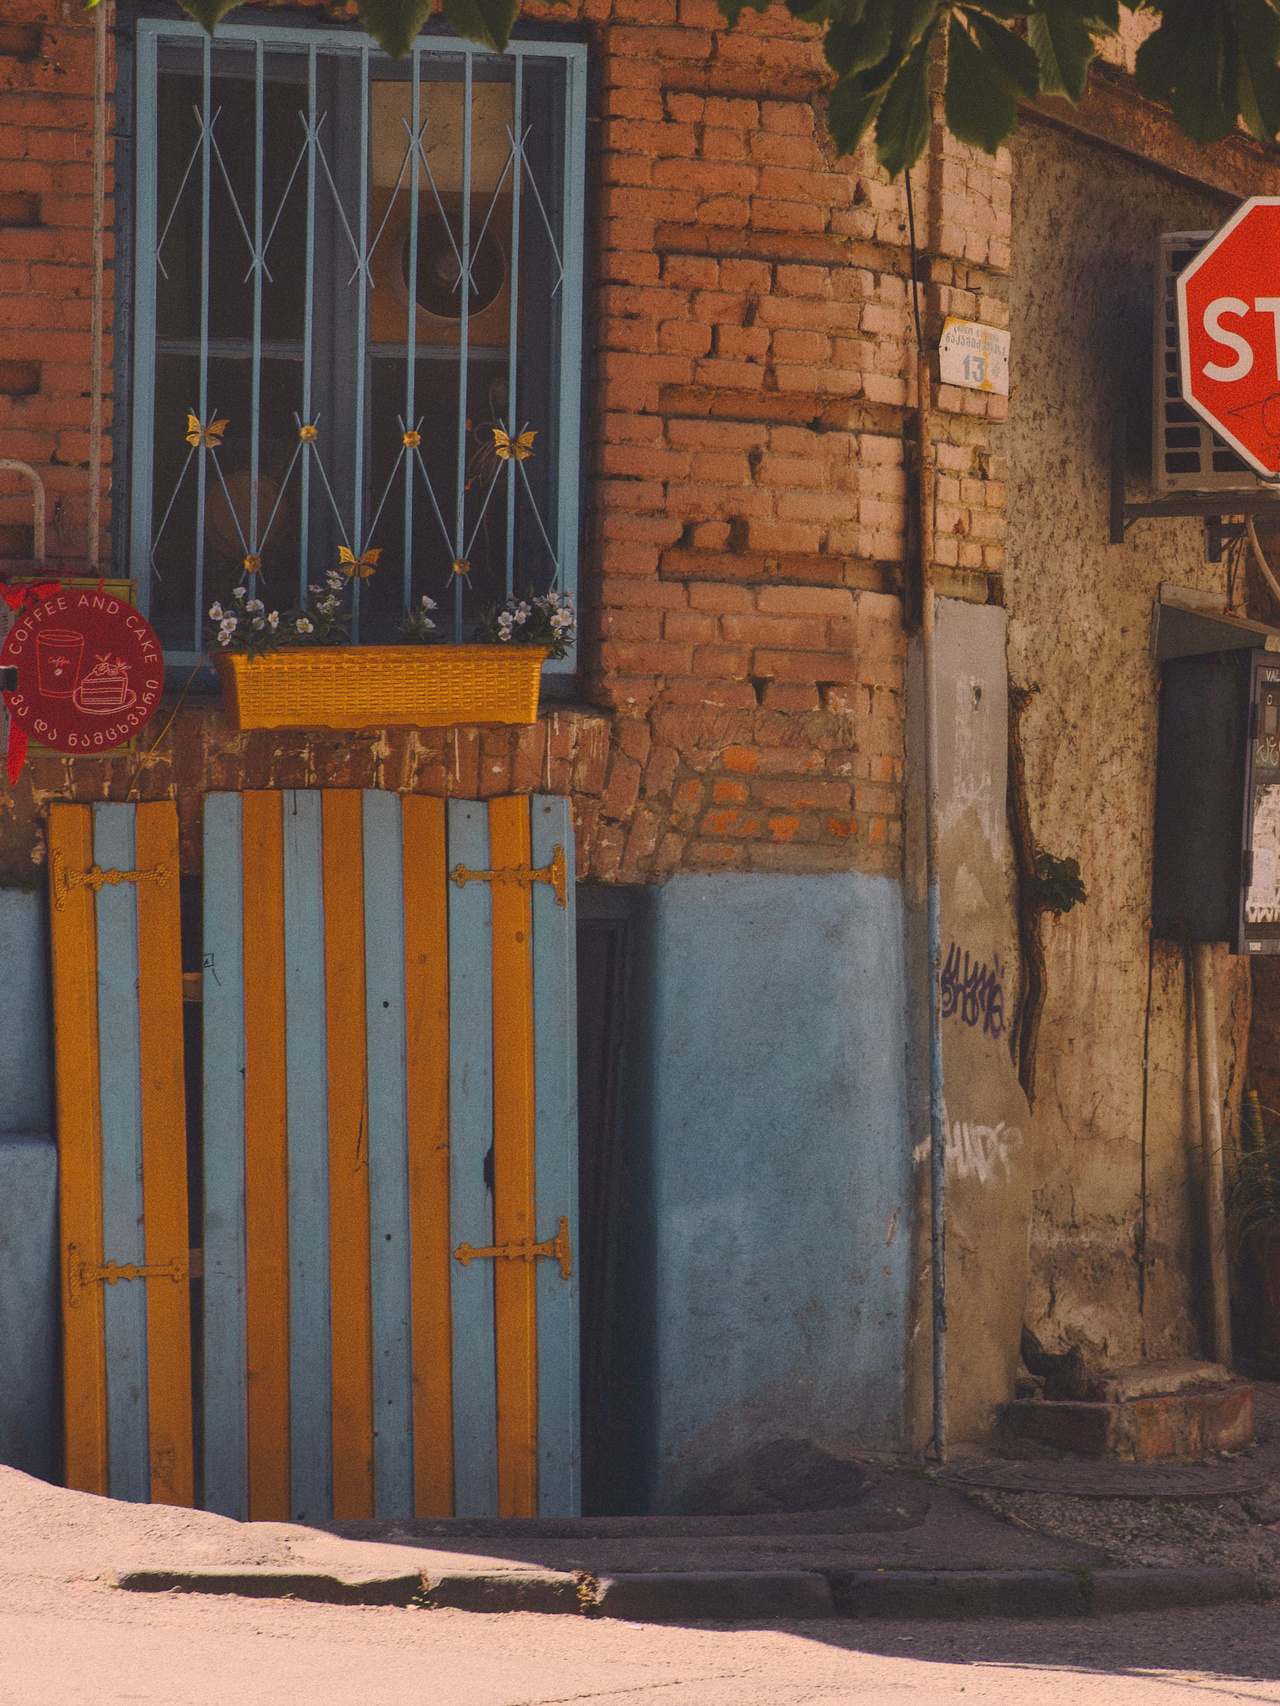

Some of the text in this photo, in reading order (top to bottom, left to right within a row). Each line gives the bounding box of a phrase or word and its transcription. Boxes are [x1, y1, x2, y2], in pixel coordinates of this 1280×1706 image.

[963, 355, 985, 383] 13
[9, 594, 158, 664] COFFEE AND CAKE
